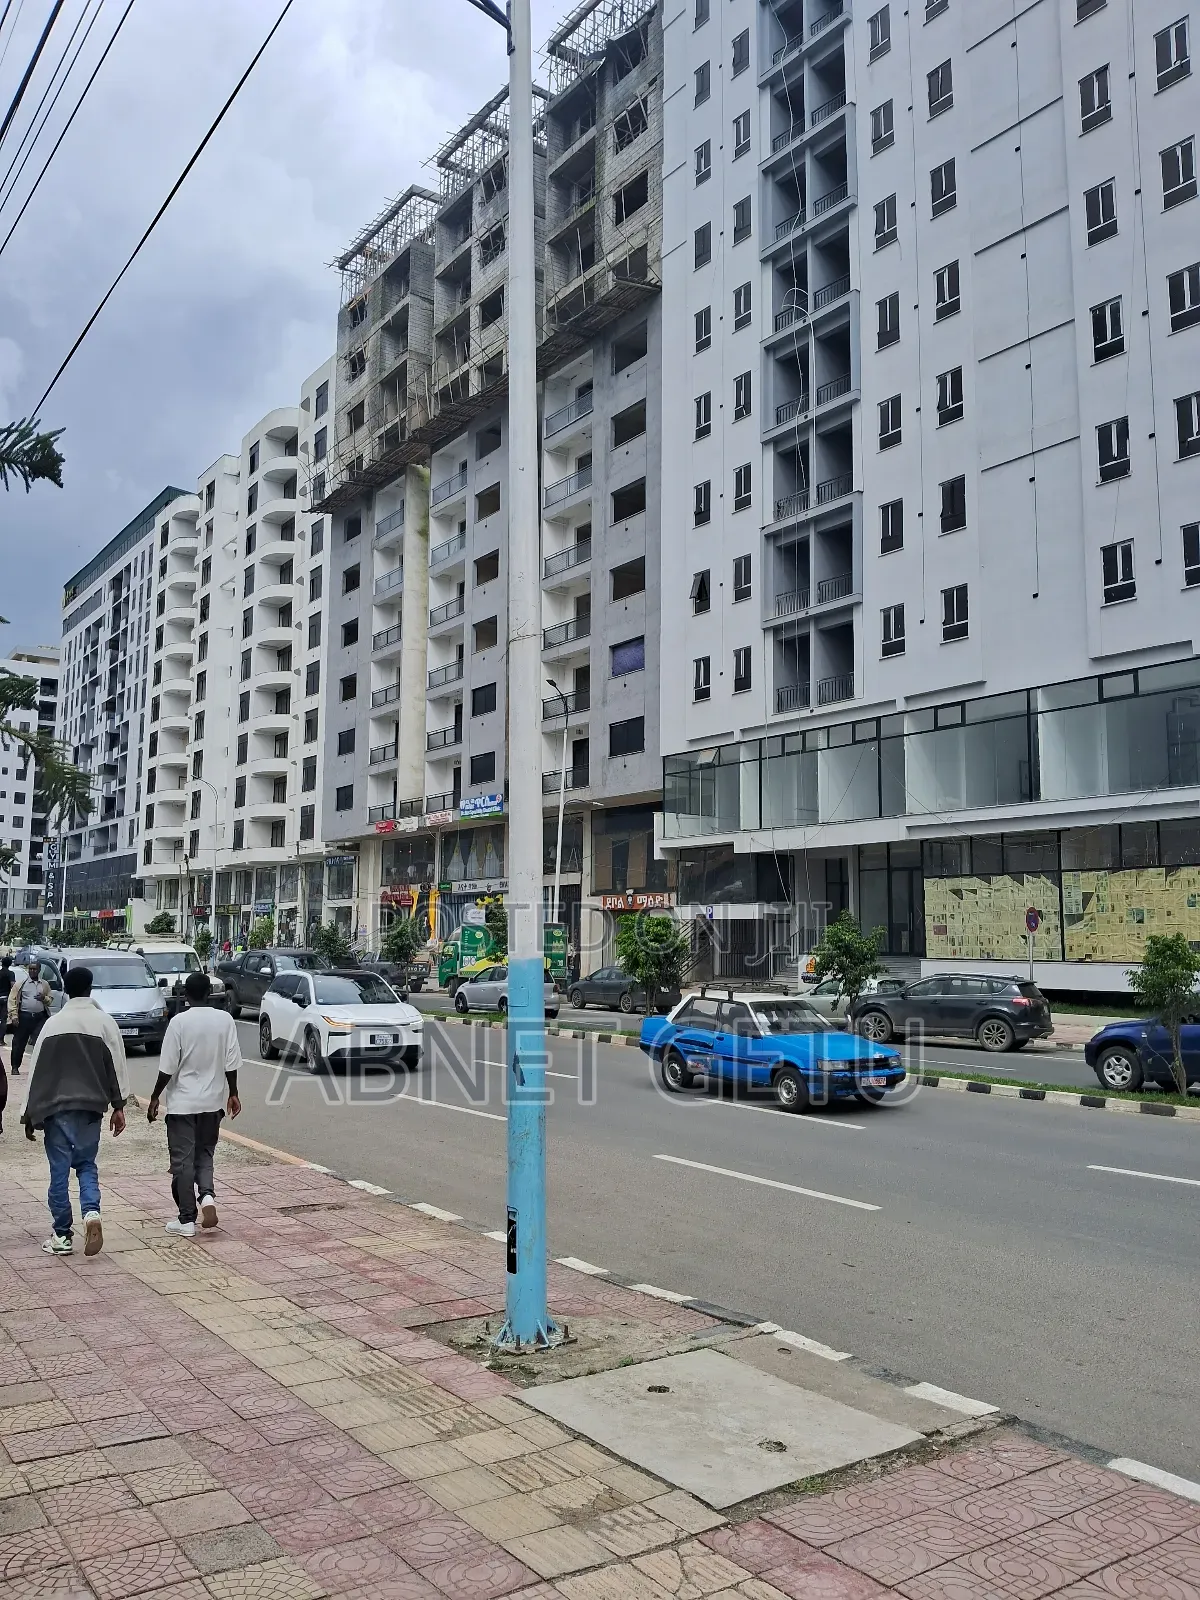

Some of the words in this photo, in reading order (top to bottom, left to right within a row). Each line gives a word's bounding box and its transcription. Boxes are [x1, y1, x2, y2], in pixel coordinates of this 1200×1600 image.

[48, 843, 57, 869] GYM
[46, 882, 55, 908] SPA
[707, 906, 713, 915] P
